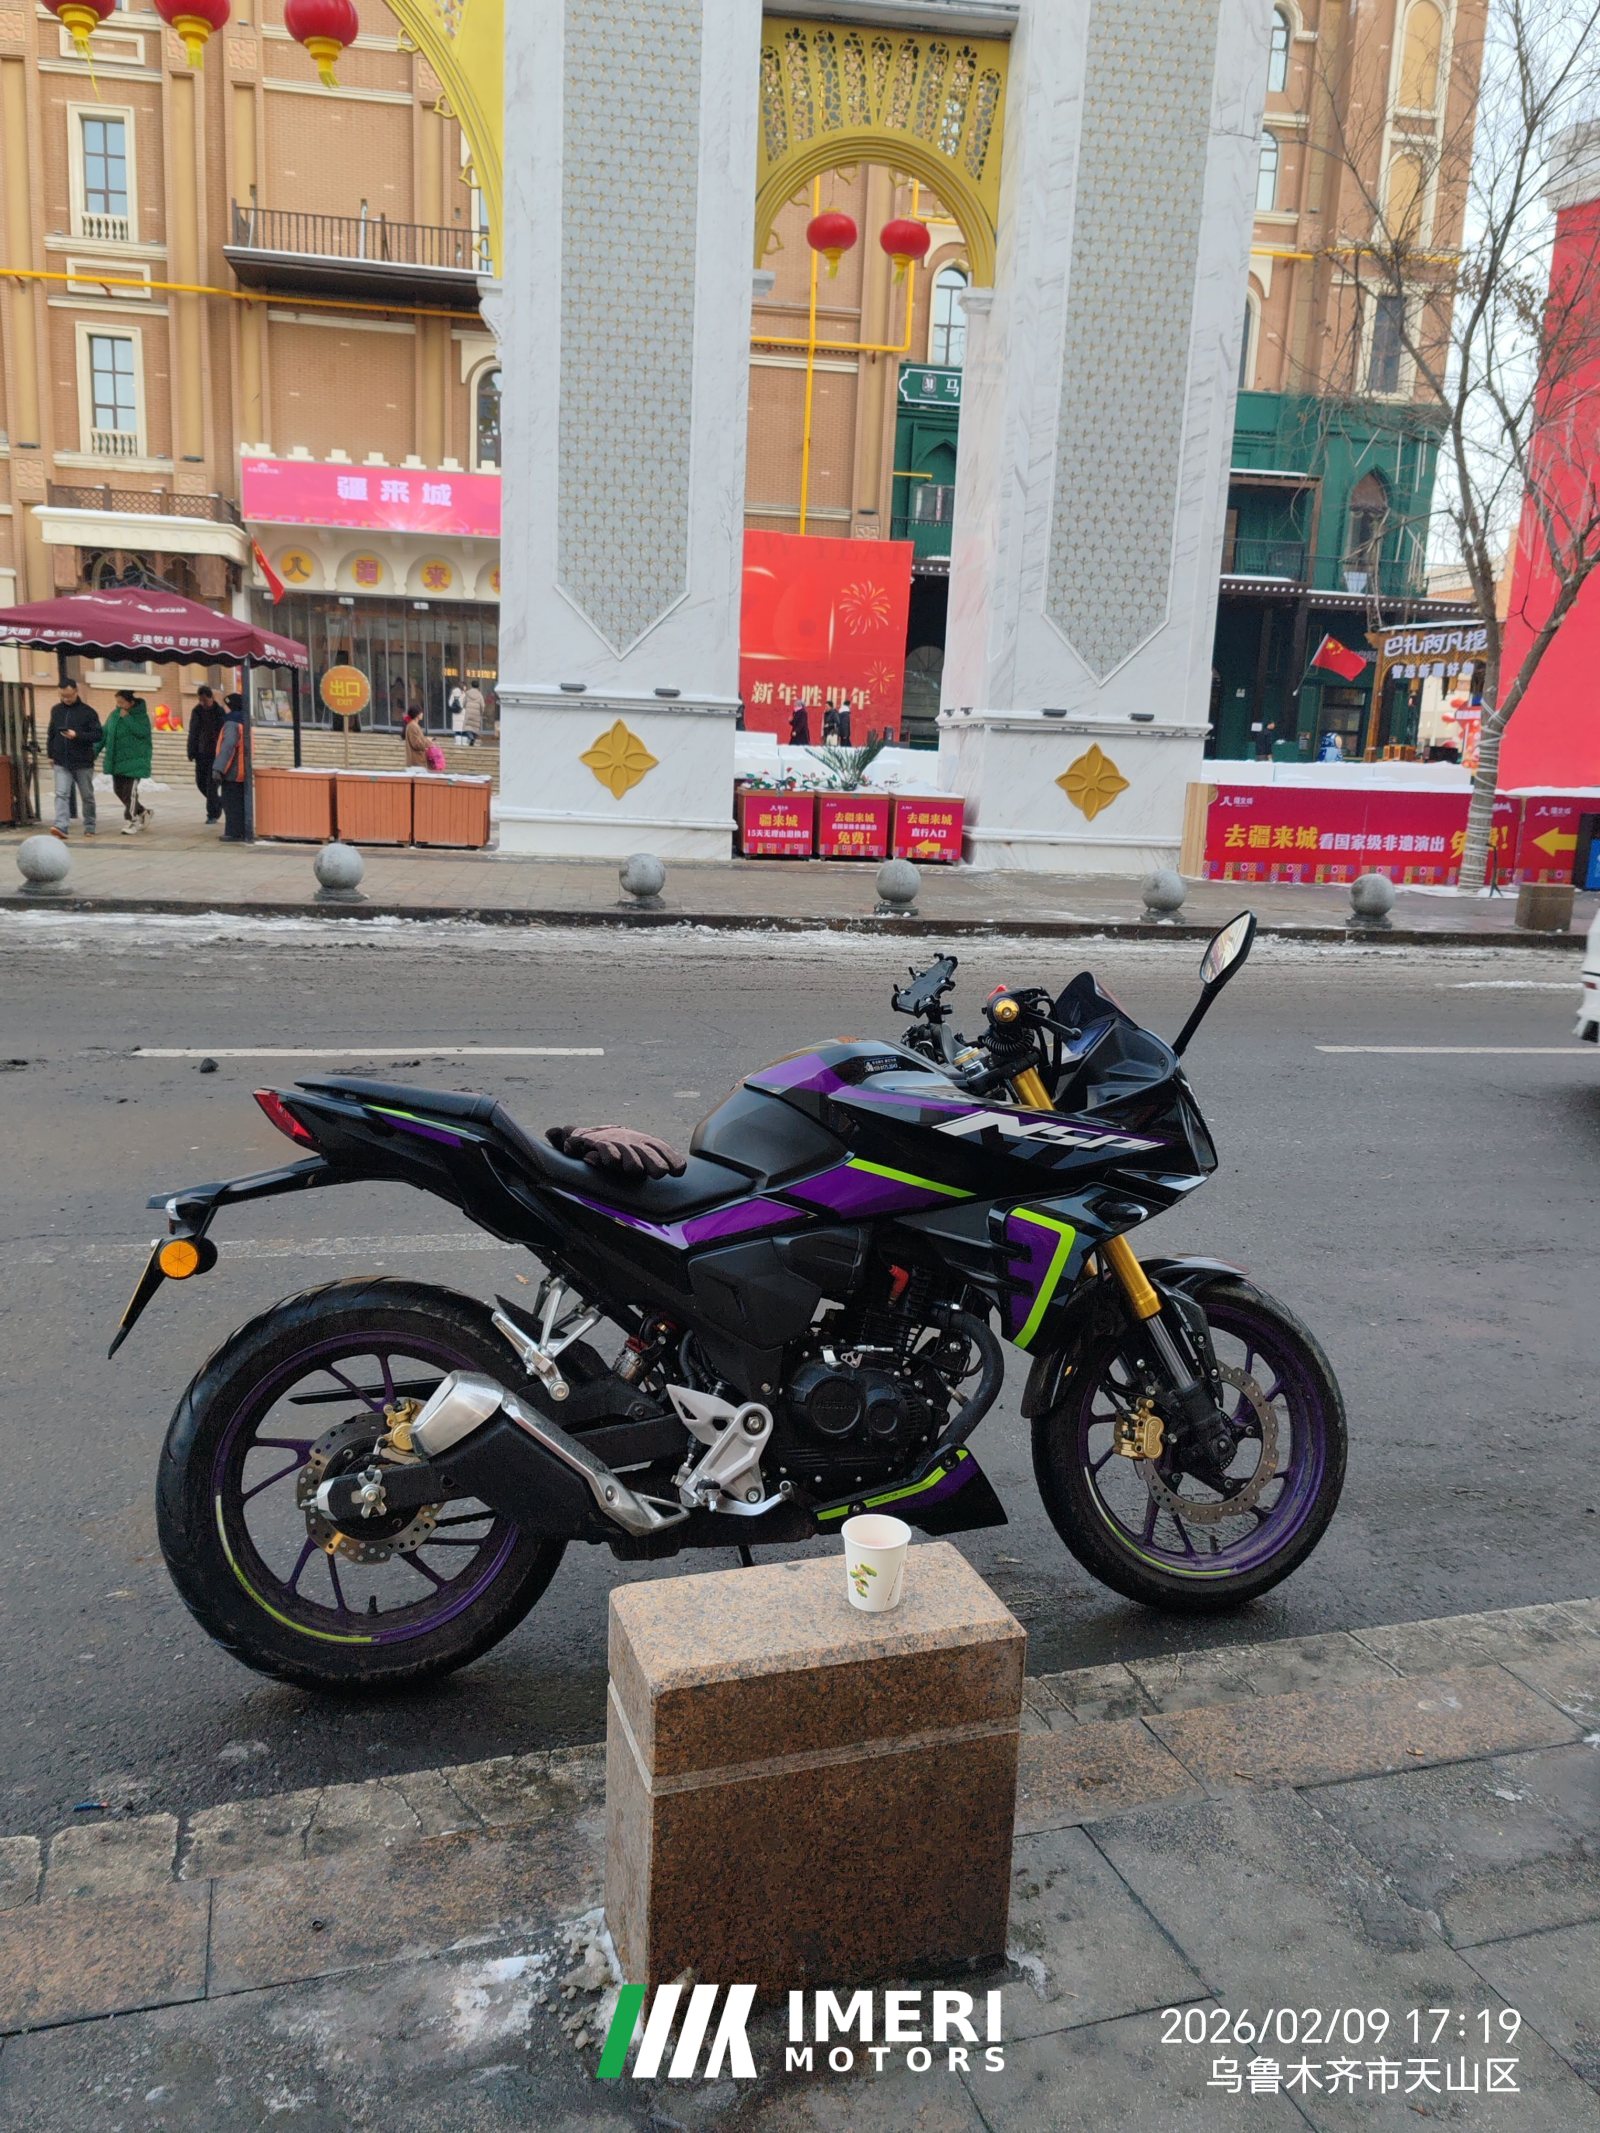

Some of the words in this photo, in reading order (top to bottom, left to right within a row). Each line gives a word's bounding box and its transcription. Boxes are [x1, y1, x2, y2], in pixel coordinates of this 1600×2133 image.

[337, 476, 452, 507] 疆来城
[329, 680, 361, 698] 出口
[751, 680, 872, 710] 新年胜旧年
[759, 813, 799, 827] 疆来城
[907, 812, 953, 826] 去疆来城
[1224, 823, 1319, 850] 去疆来城
[1319, 832, 1446, 853] 看国家级非遗演出
